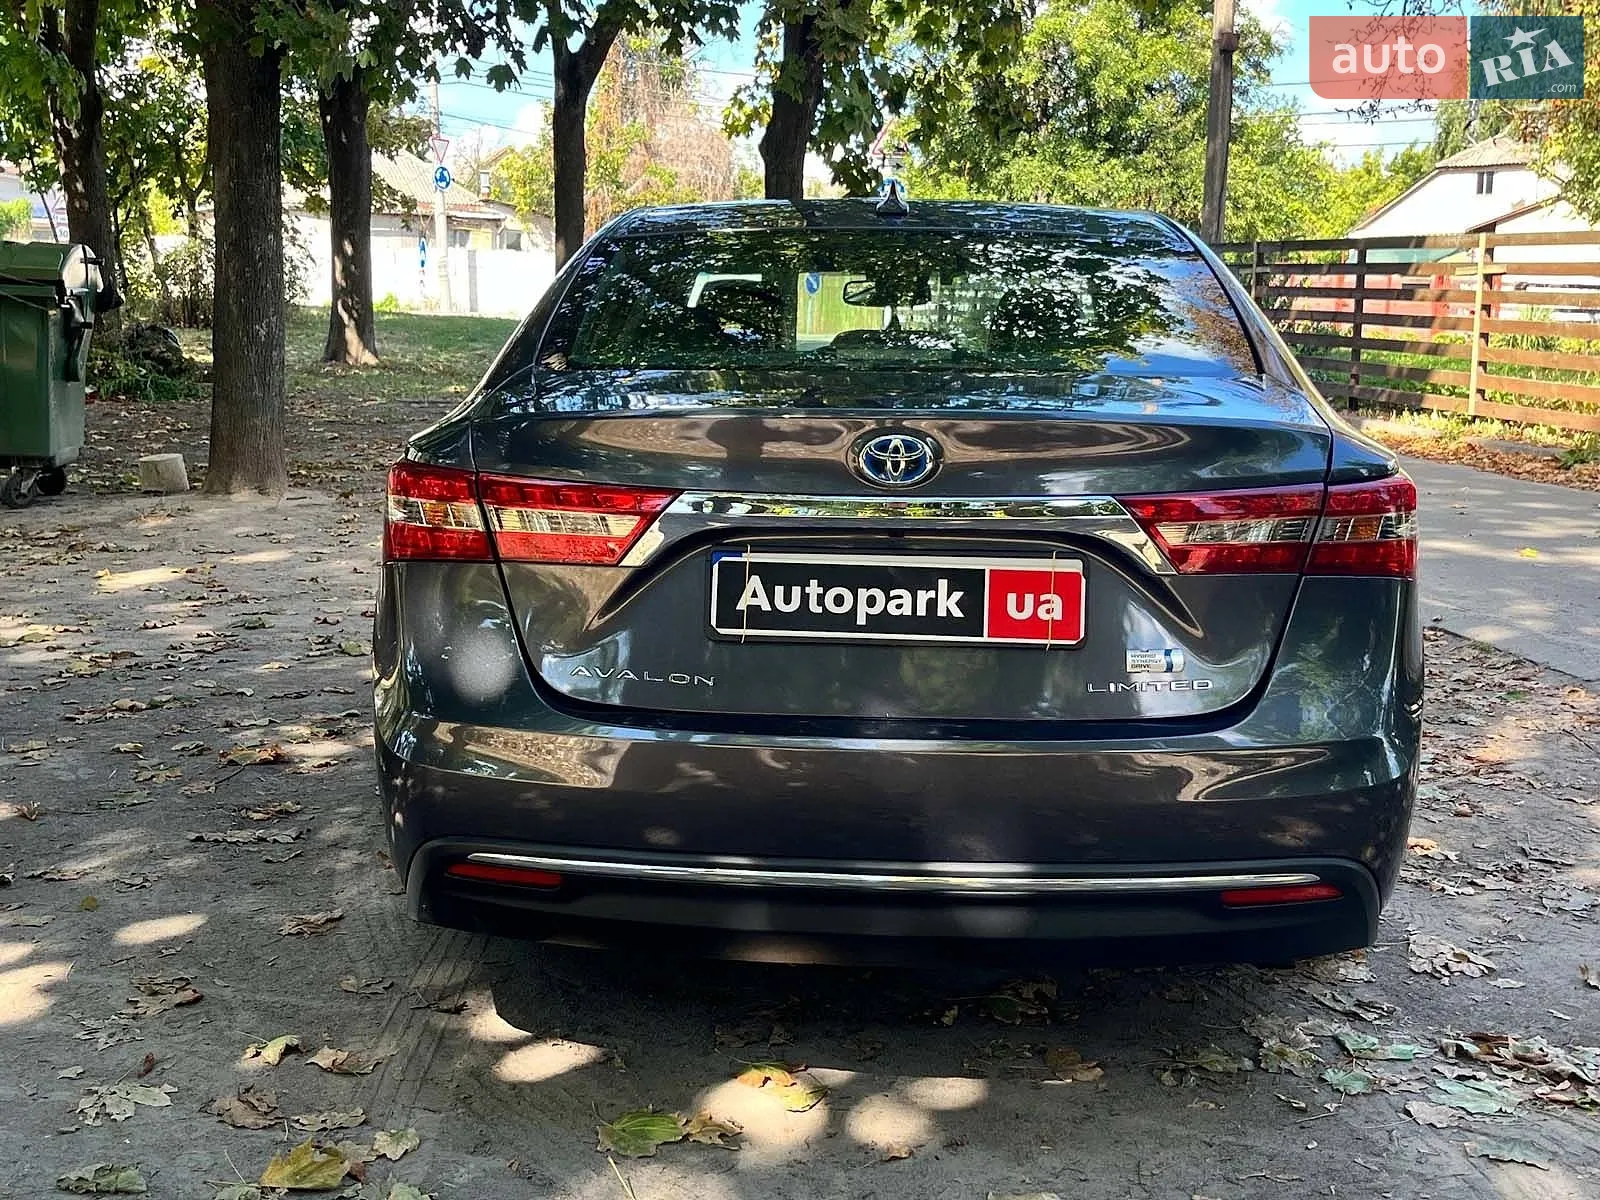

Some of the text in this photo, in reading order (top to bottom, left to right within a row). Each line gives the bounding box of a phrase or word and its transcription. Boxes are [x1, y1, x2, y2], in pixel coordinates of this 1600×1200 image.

[735, 574, 1064, 625] Autopark ua
[570, 665, 716, 687] AVALON
[1087, 679, 1214, 693] LIMITED
